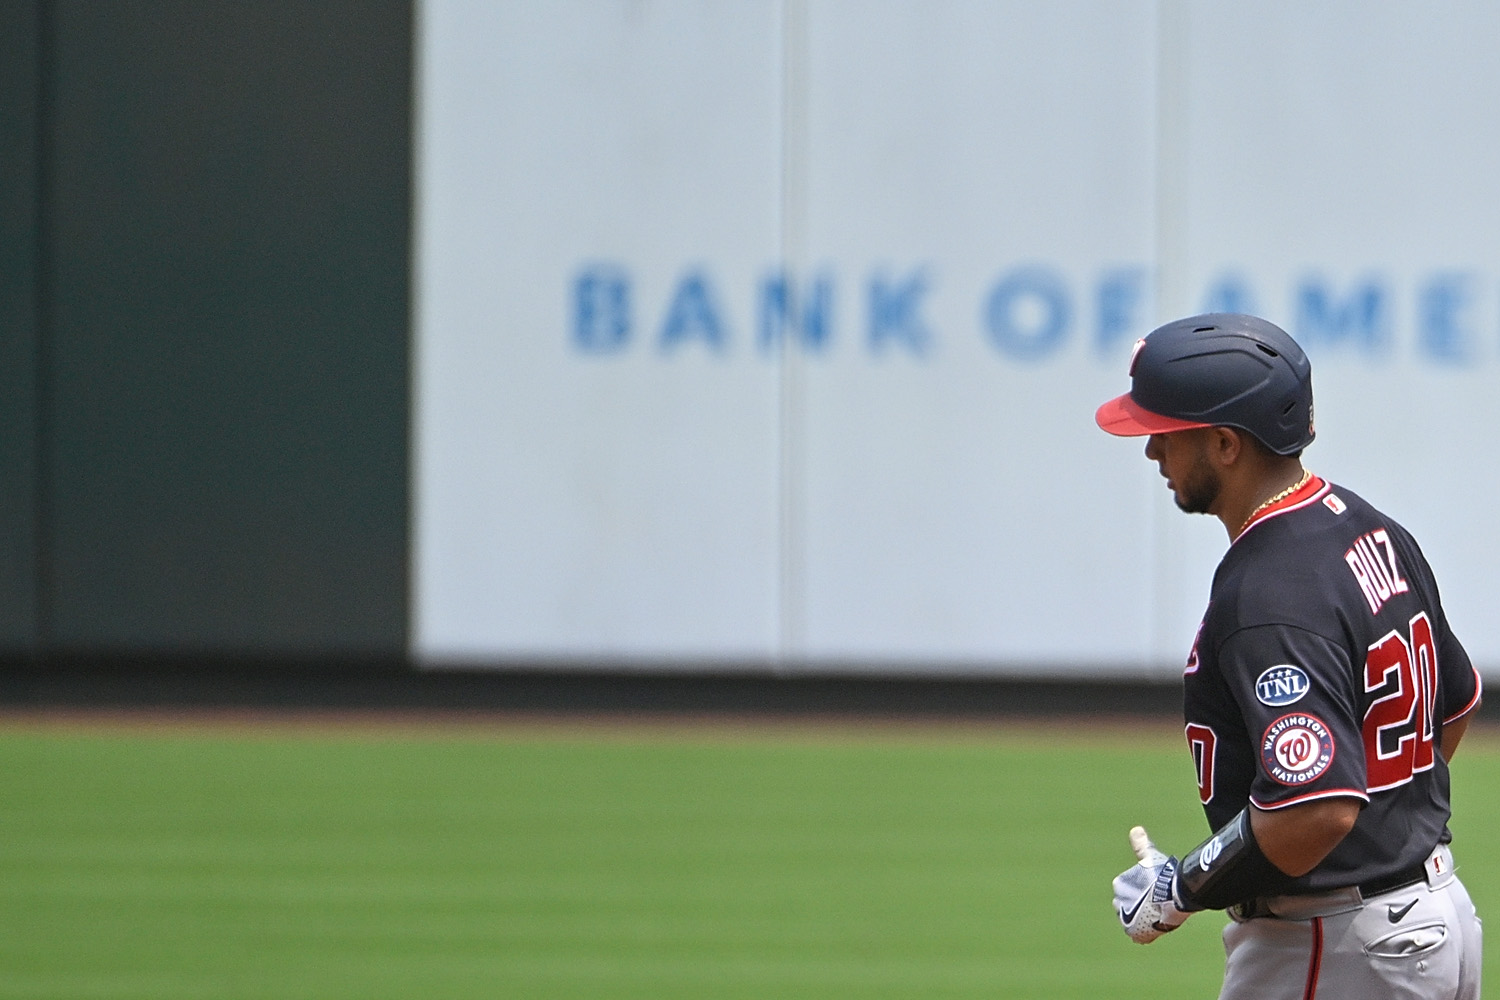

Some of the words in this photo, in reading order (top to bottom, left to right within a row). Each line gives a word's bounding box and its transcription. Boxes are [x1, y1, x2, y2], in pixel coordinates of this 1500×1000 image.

[569, 260, 934, 358] BANK
[980, 260, 1148, 364] OF
[1344, 527, 1409, 616] RUIZ
[1258, 675, 1307, 700] TNL
[1362, 610, 1438, 794] 20
[1264, 716, 1328, 751] WASHINGTON
[1271, 754, 1330, 783] NATIONALS
